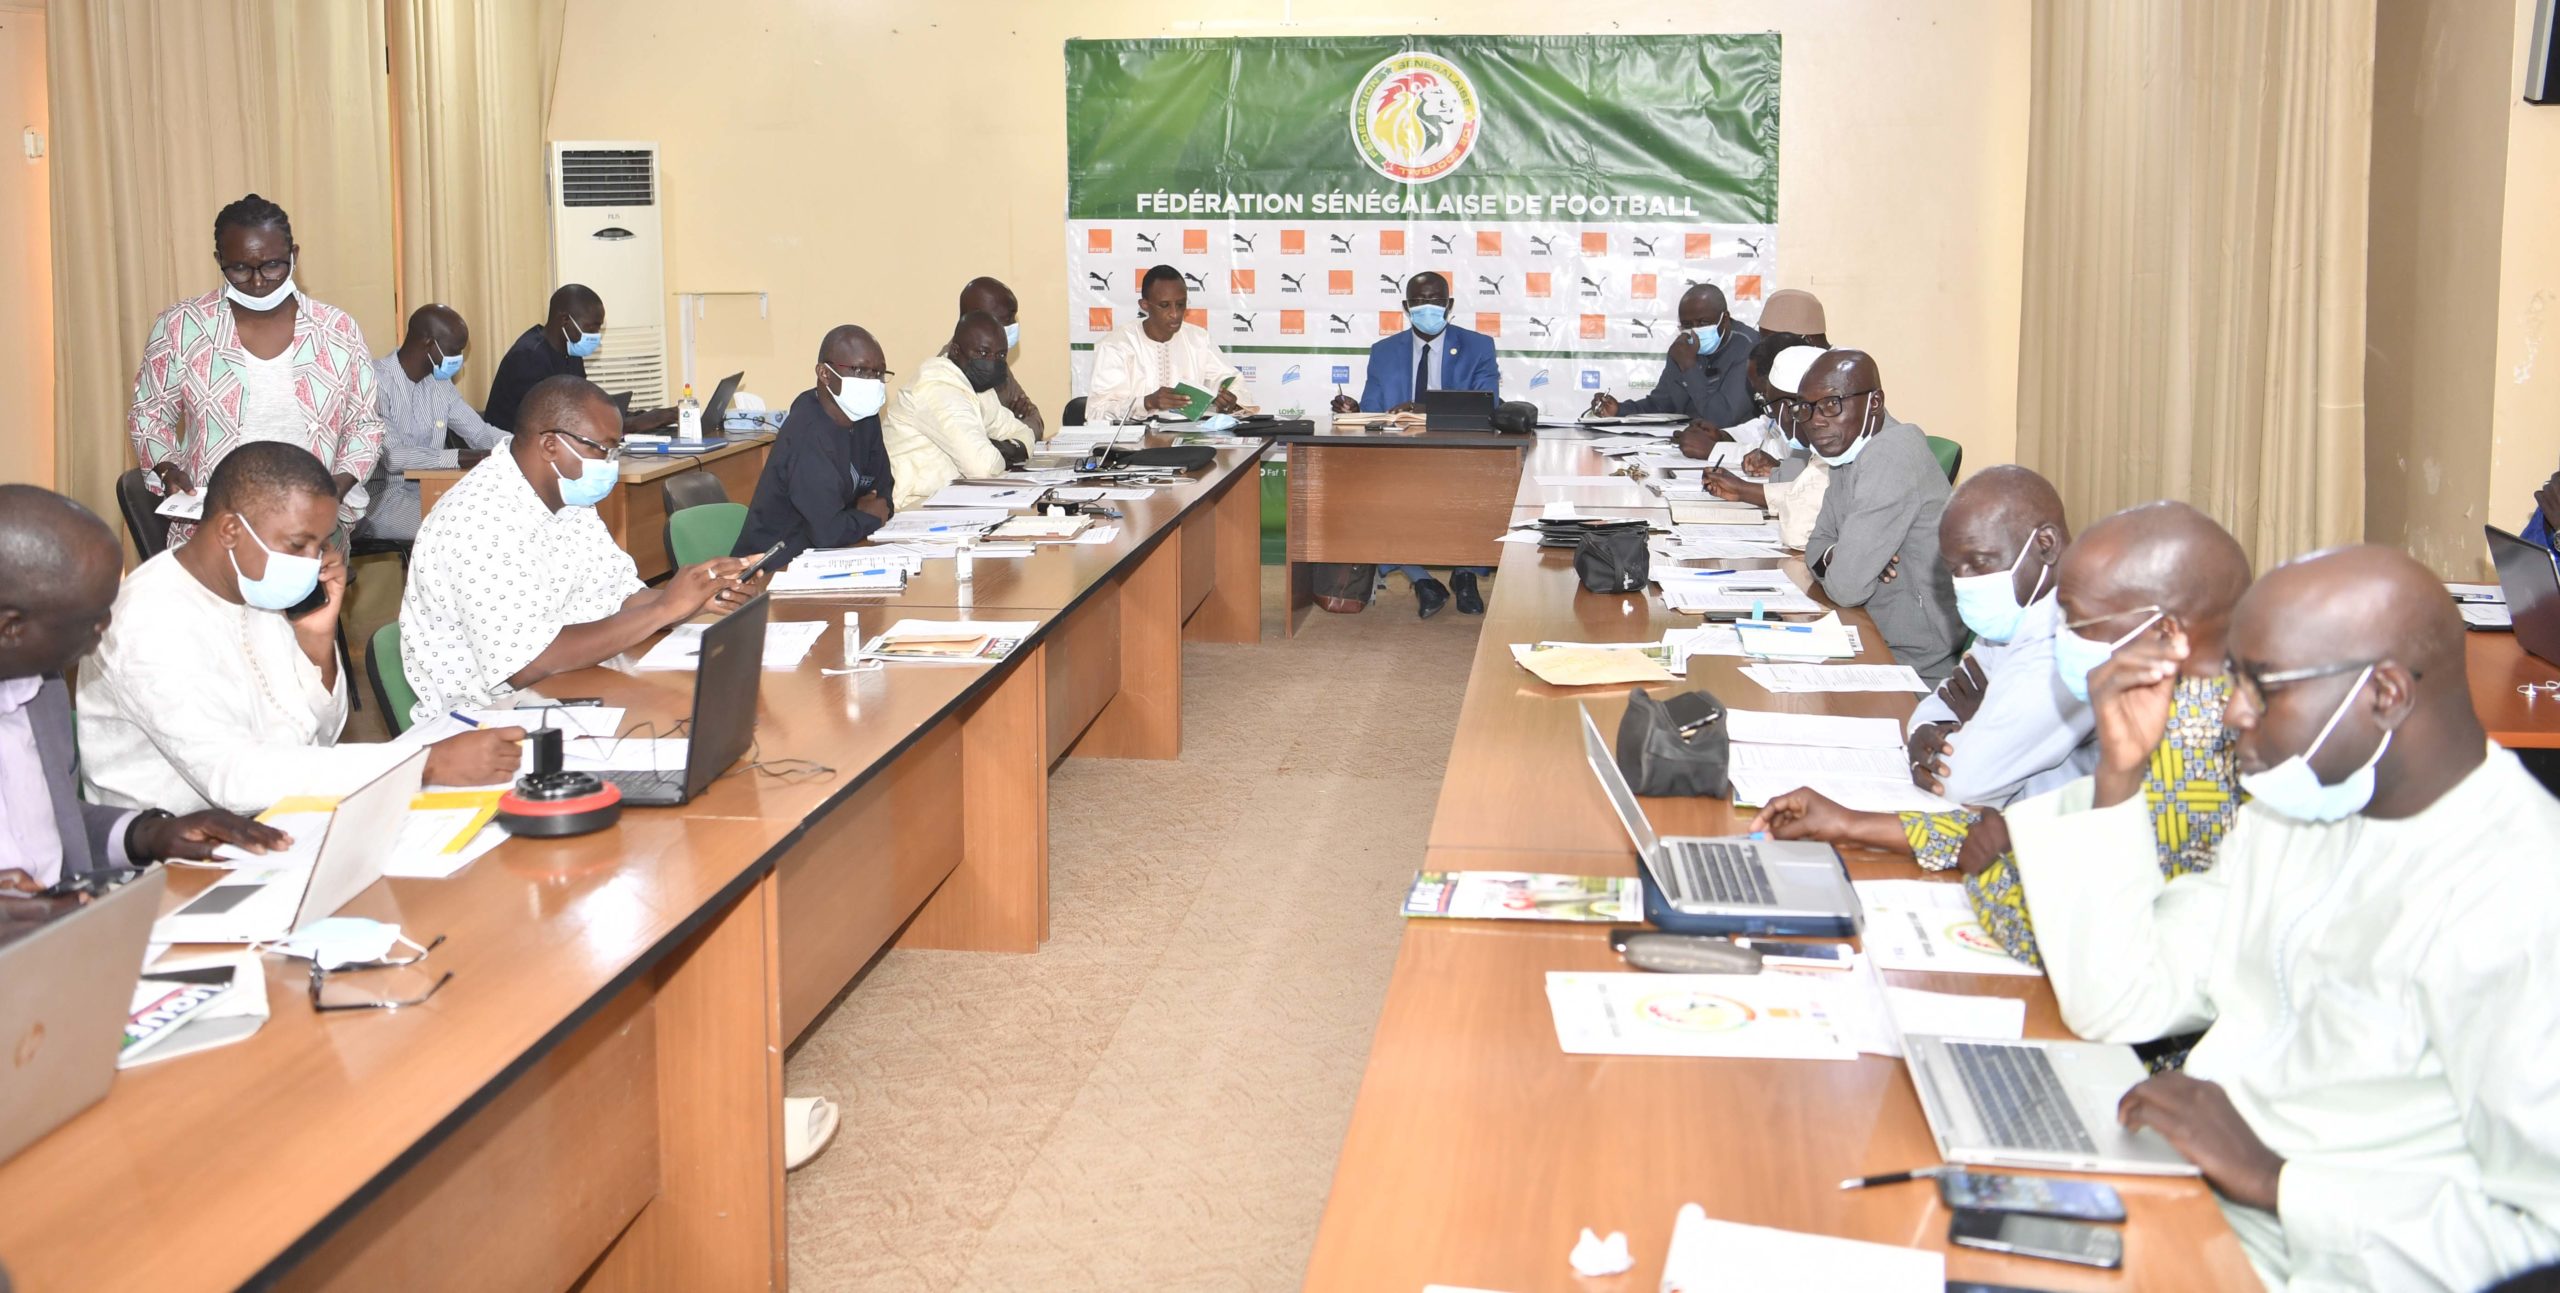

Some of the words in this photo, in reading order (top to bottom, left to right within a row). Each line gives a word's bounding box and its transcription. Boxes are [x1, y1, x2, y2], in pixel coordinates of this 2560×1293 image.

[1460, 128, 1471, 146] DE
[1399, 148, 1462, 176] FOOTBALL
[1136, 188, 1303, 213] FÉDÉRATION
[1311, 188, 1497, 214] SÉNÉGALAISE
[1505, 194, 1542, 214] DE
[1550, 194, 1700, 217] FOOTBALL
